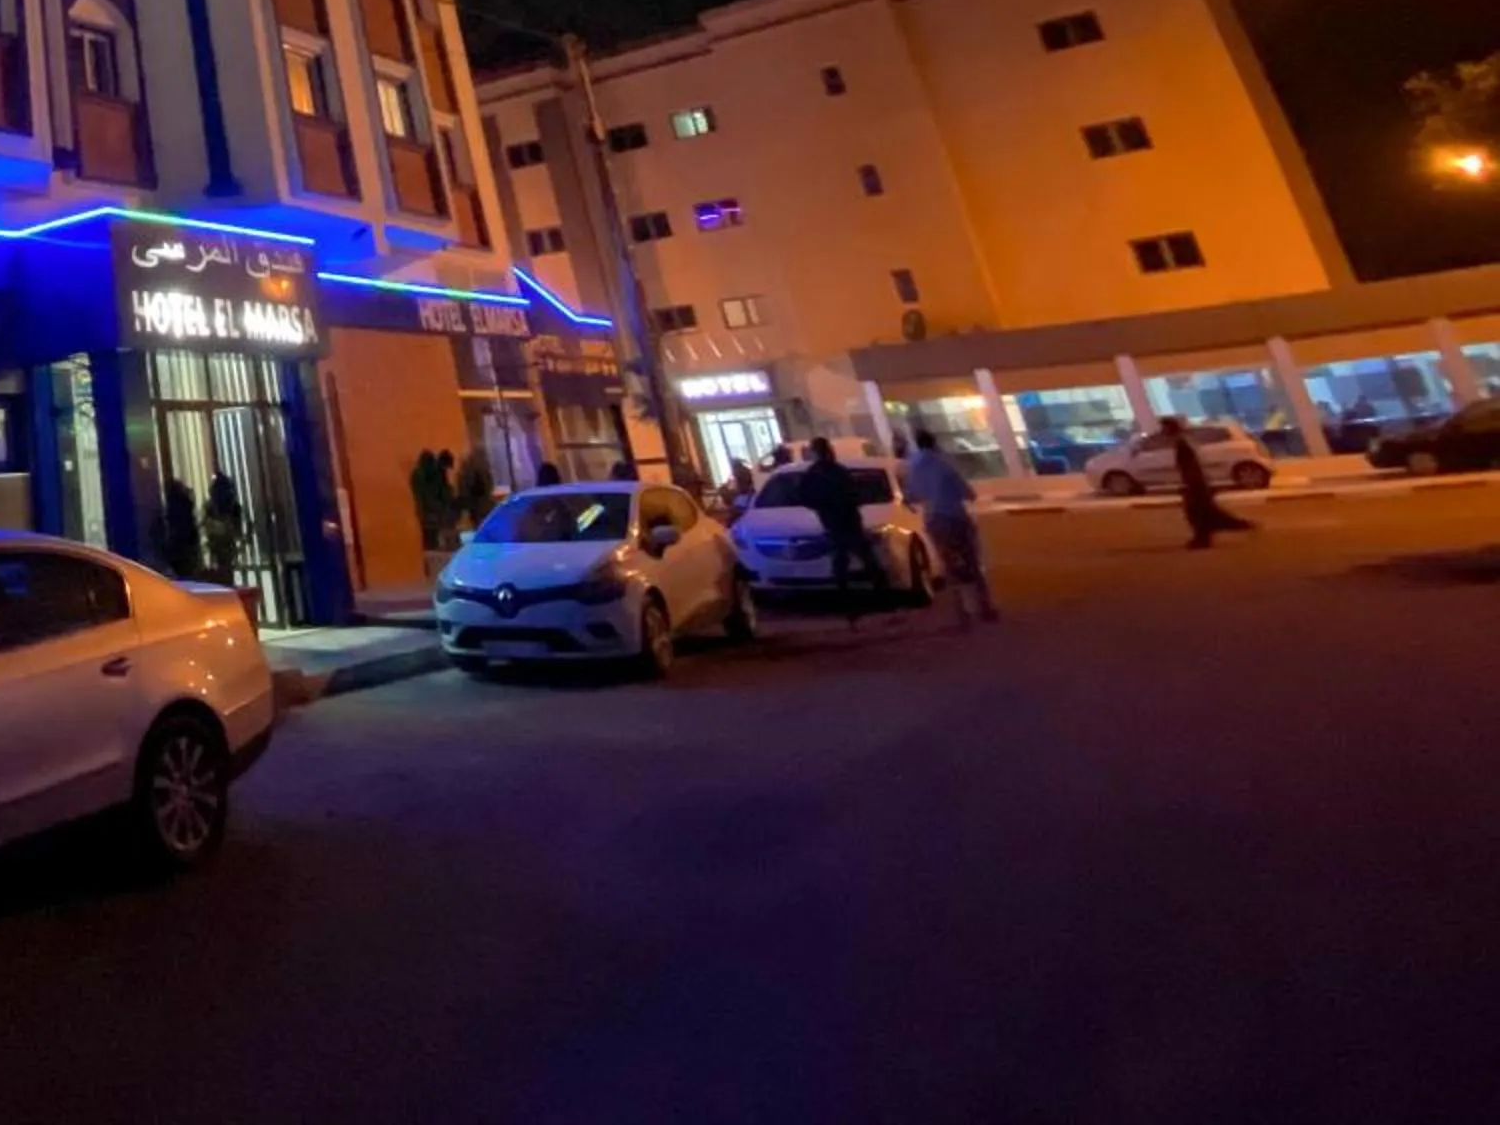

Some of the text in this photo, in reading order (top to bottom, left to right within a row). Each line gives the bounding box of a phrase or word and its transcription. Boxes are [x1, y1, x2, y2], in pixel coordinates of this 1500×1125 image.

[132, 290, 319, 345] HOTEL EL MARSA
